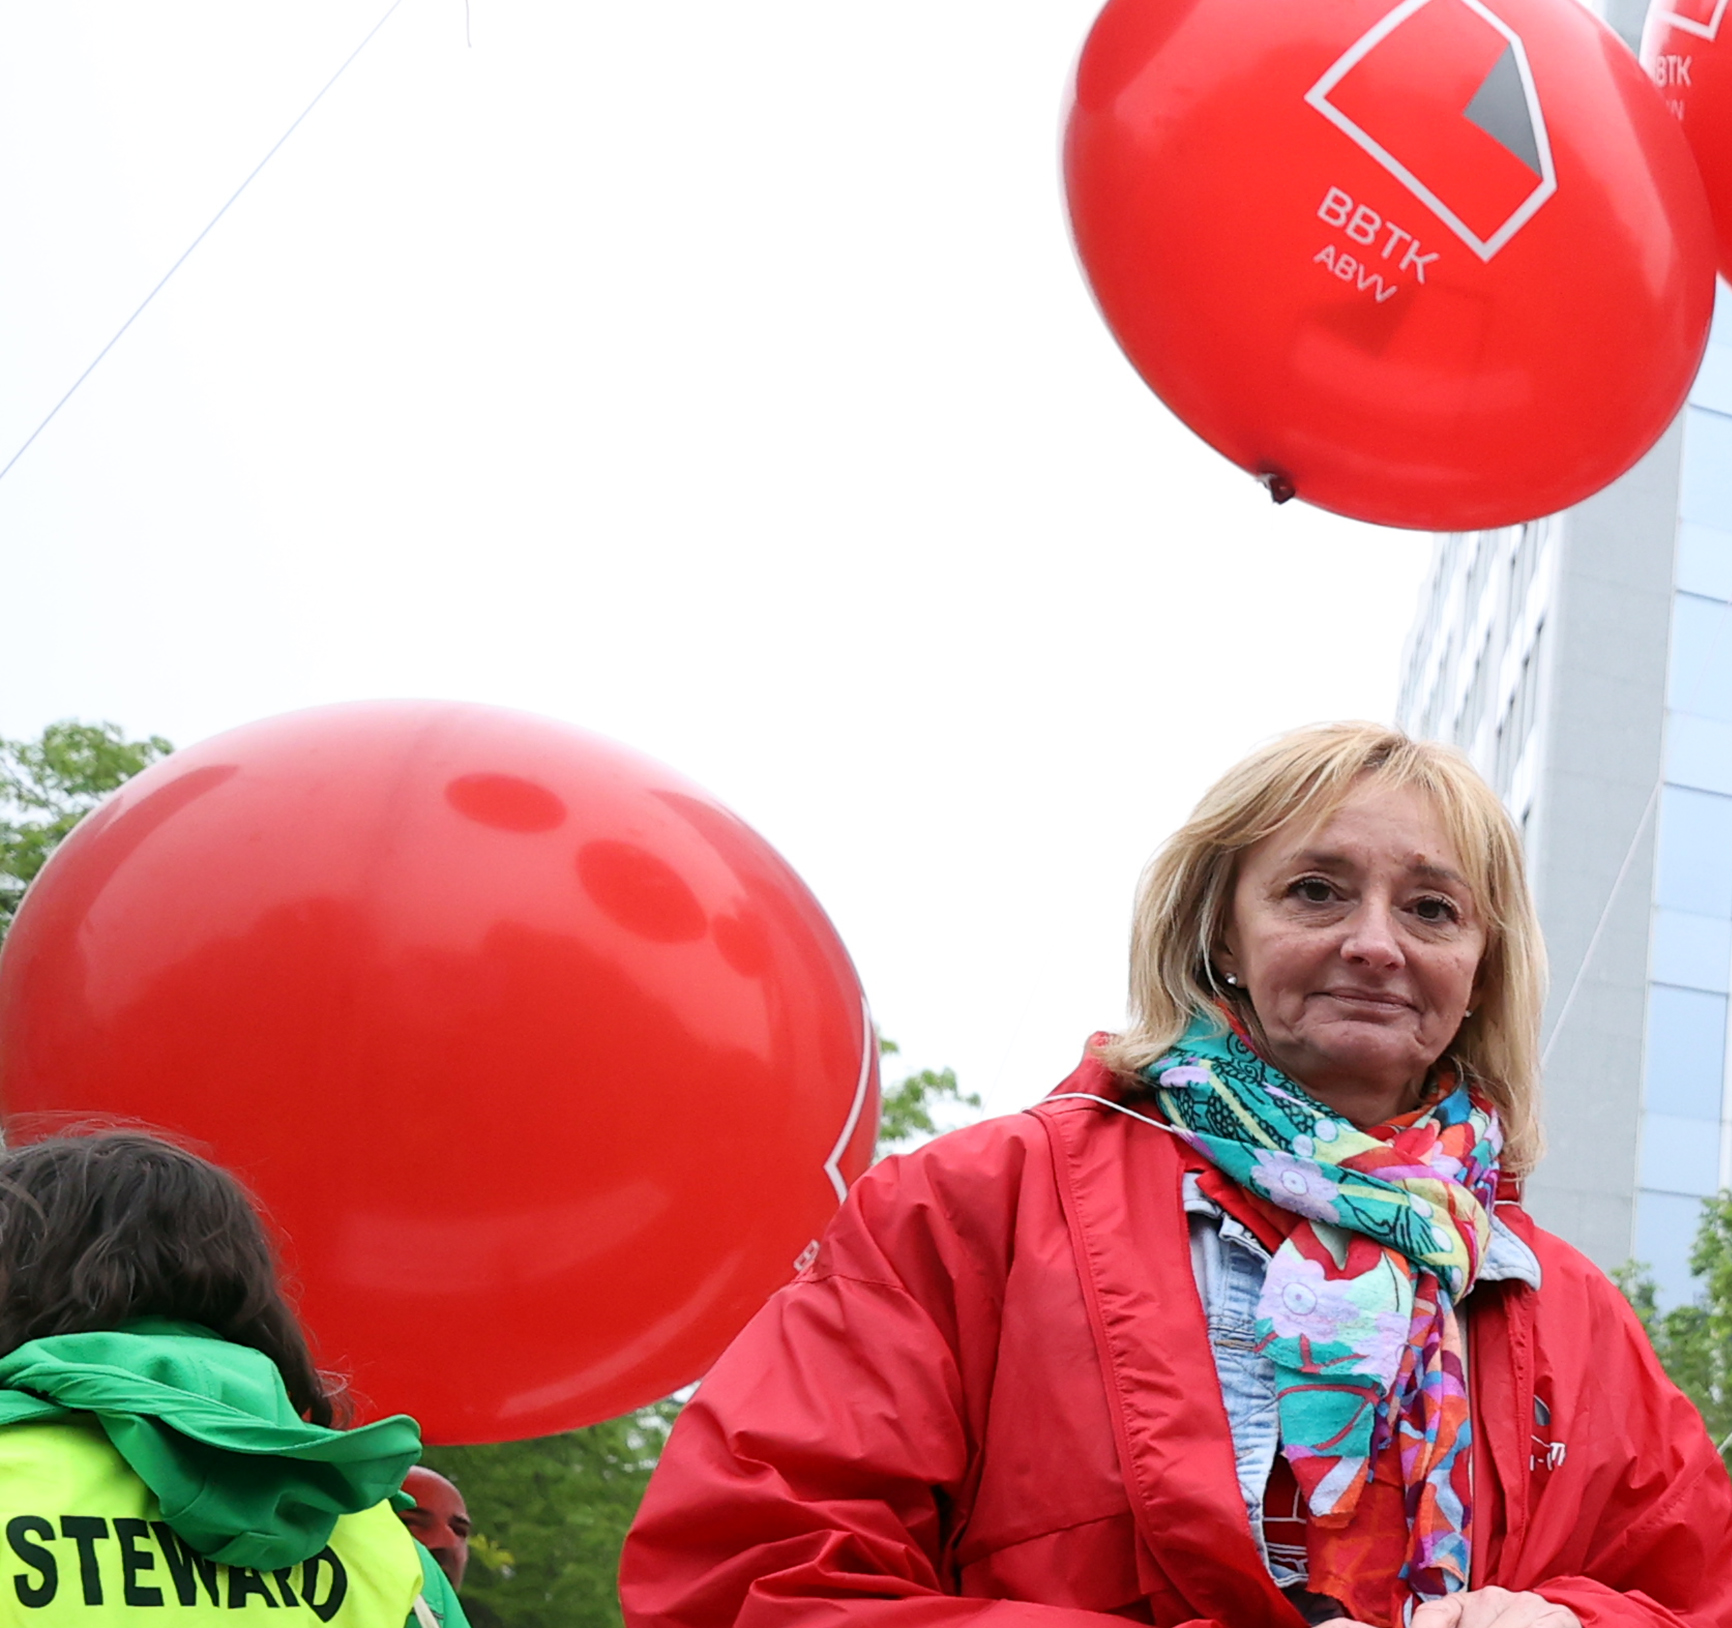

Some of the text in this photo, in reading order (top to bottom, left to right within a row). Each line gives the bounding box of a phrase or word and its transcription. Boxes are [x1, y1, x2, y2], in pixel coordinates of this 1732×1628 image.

[1655, 54, 1693, 88] BTK
[1316, 184, 1440, 285] BBTK
[1312, 243, 1398, 304] ABVV
